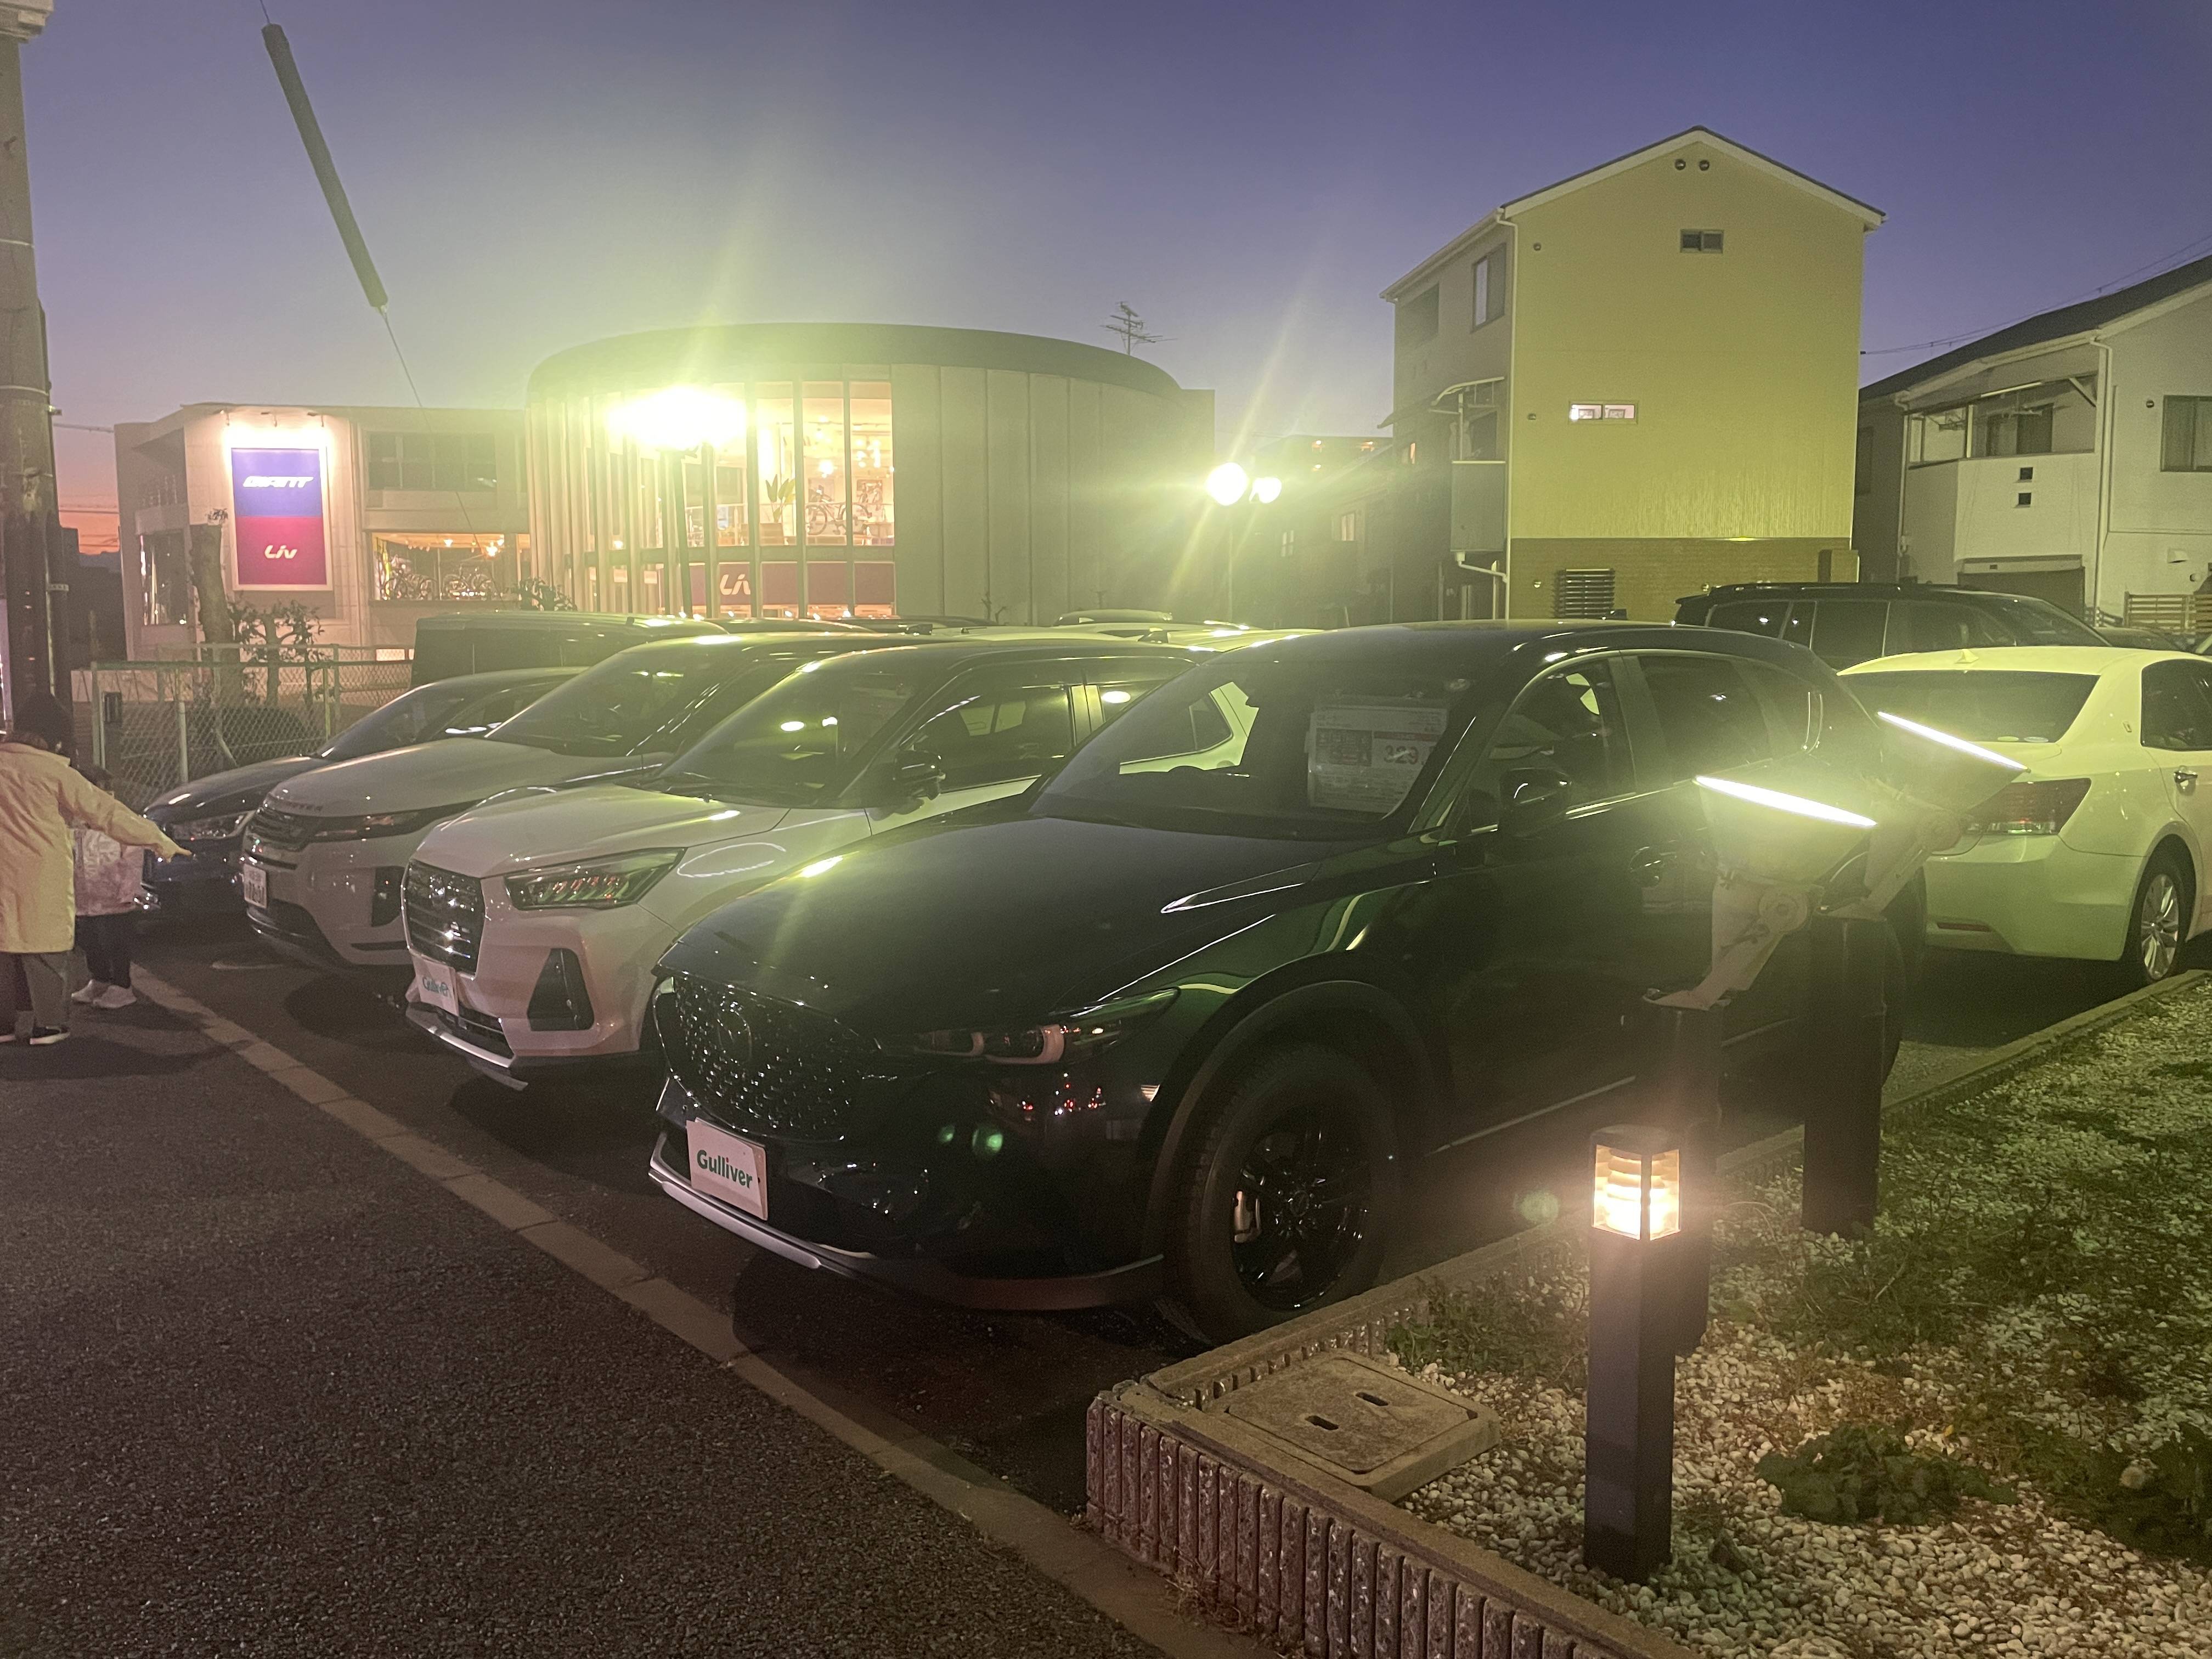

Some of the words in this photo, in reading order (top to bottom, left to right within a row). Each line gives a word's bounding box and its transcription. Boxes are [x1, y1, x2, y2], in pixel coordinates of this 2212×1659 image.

[242, 476, 314, 488] GIANT
[264, 545, 297, 558] Liv
[697, 1149, 753, 1189] Gulliver
